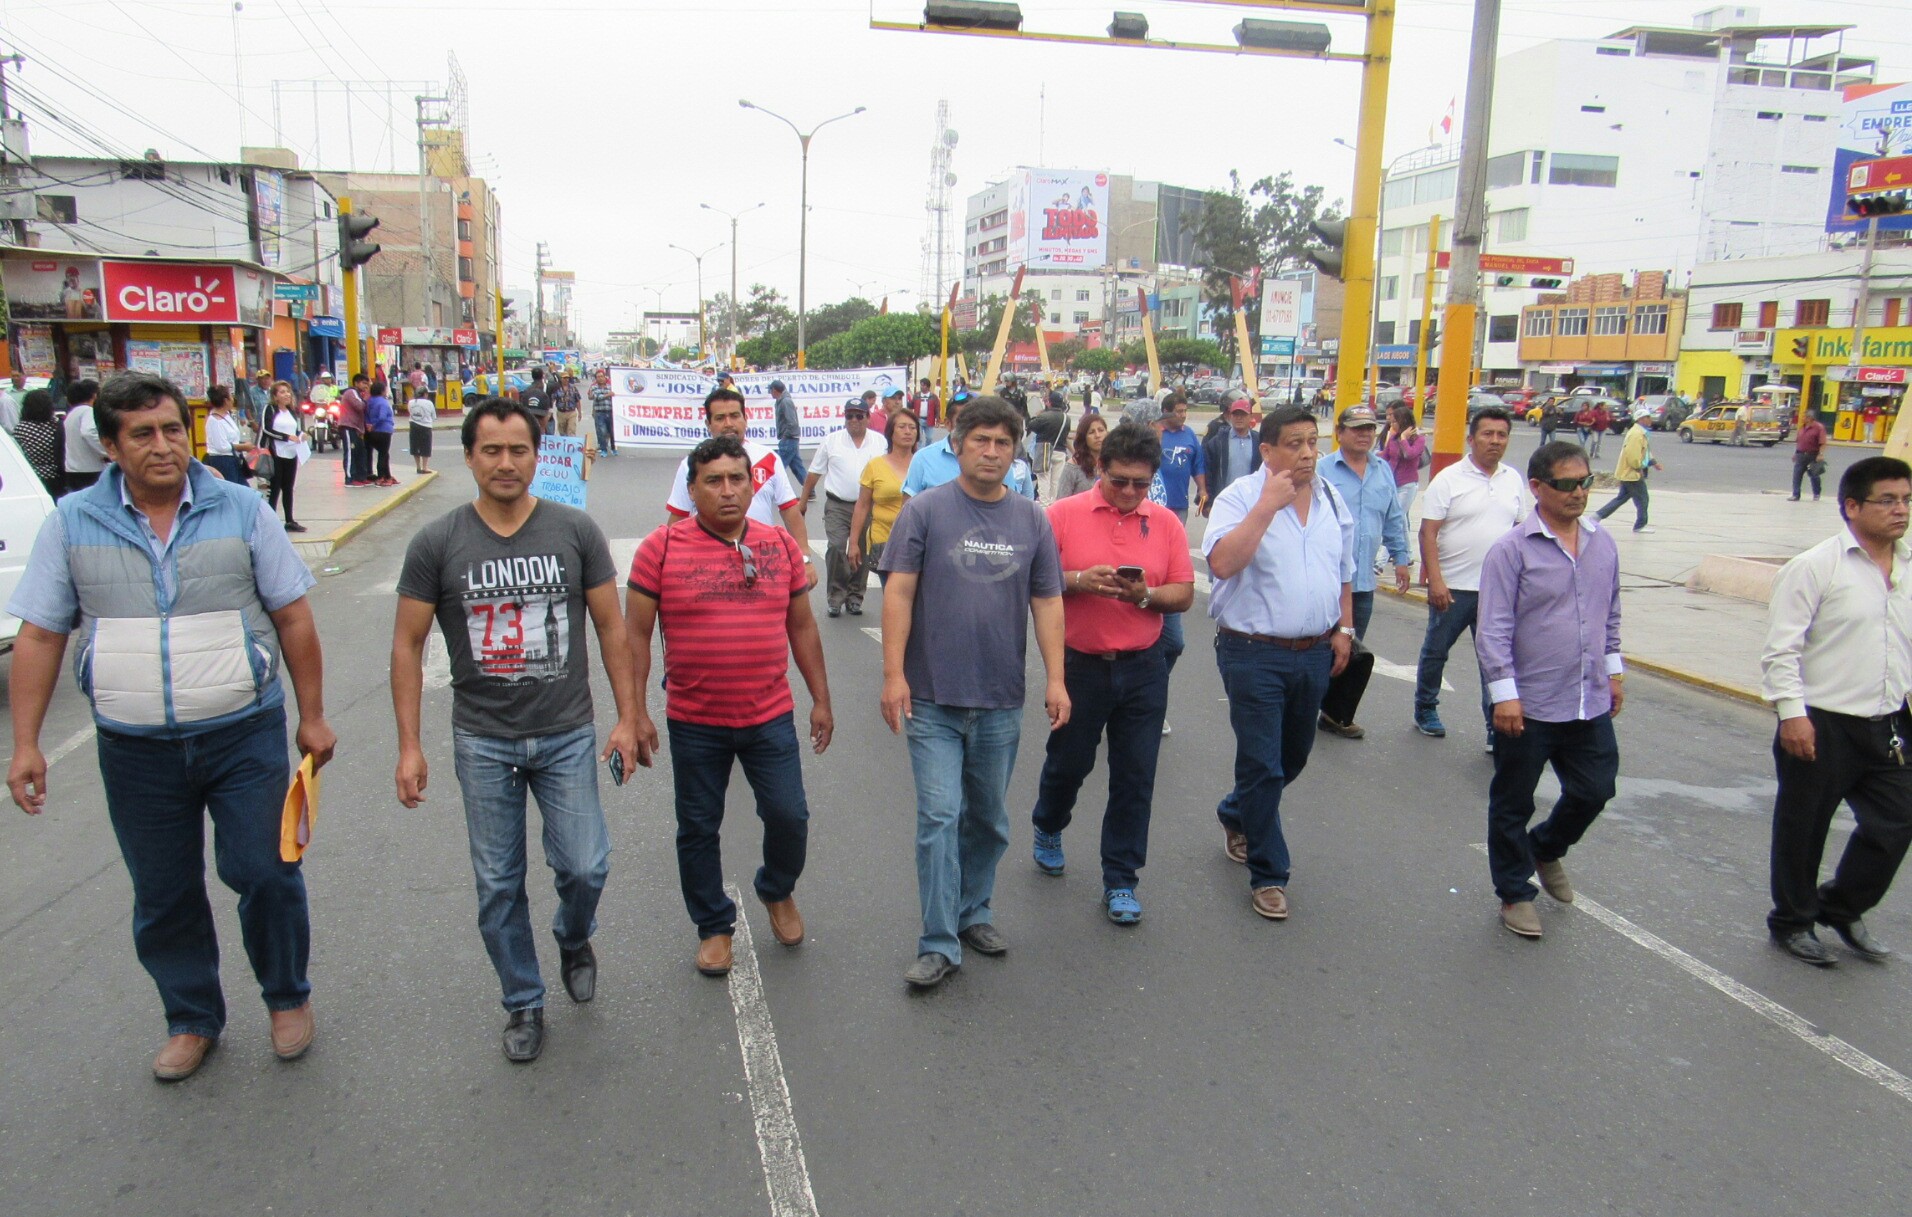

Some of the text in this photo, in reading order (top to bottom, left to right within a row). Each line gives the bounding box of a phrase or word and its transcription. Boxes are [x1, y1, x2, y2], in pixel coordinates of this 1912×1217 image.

[1484, 262, 1509, 270] MANUEL
[119, 284, 212, 312] Claro
[382, 333, 396, 343] Claro
[456, 334, 471, 343] Claro
[1816, 335, 1912, 357] Inkfarm
[1865, 371, 1893, 381] Claro
[803, 406, 830, 419] LAS
[541, 481, 581, 497] TRABAJO
[964, 540, 1014, 551] NAUTICA
[964, 547, 1015, 556] COMPETITION
[472, 602, 524, 646] 73
